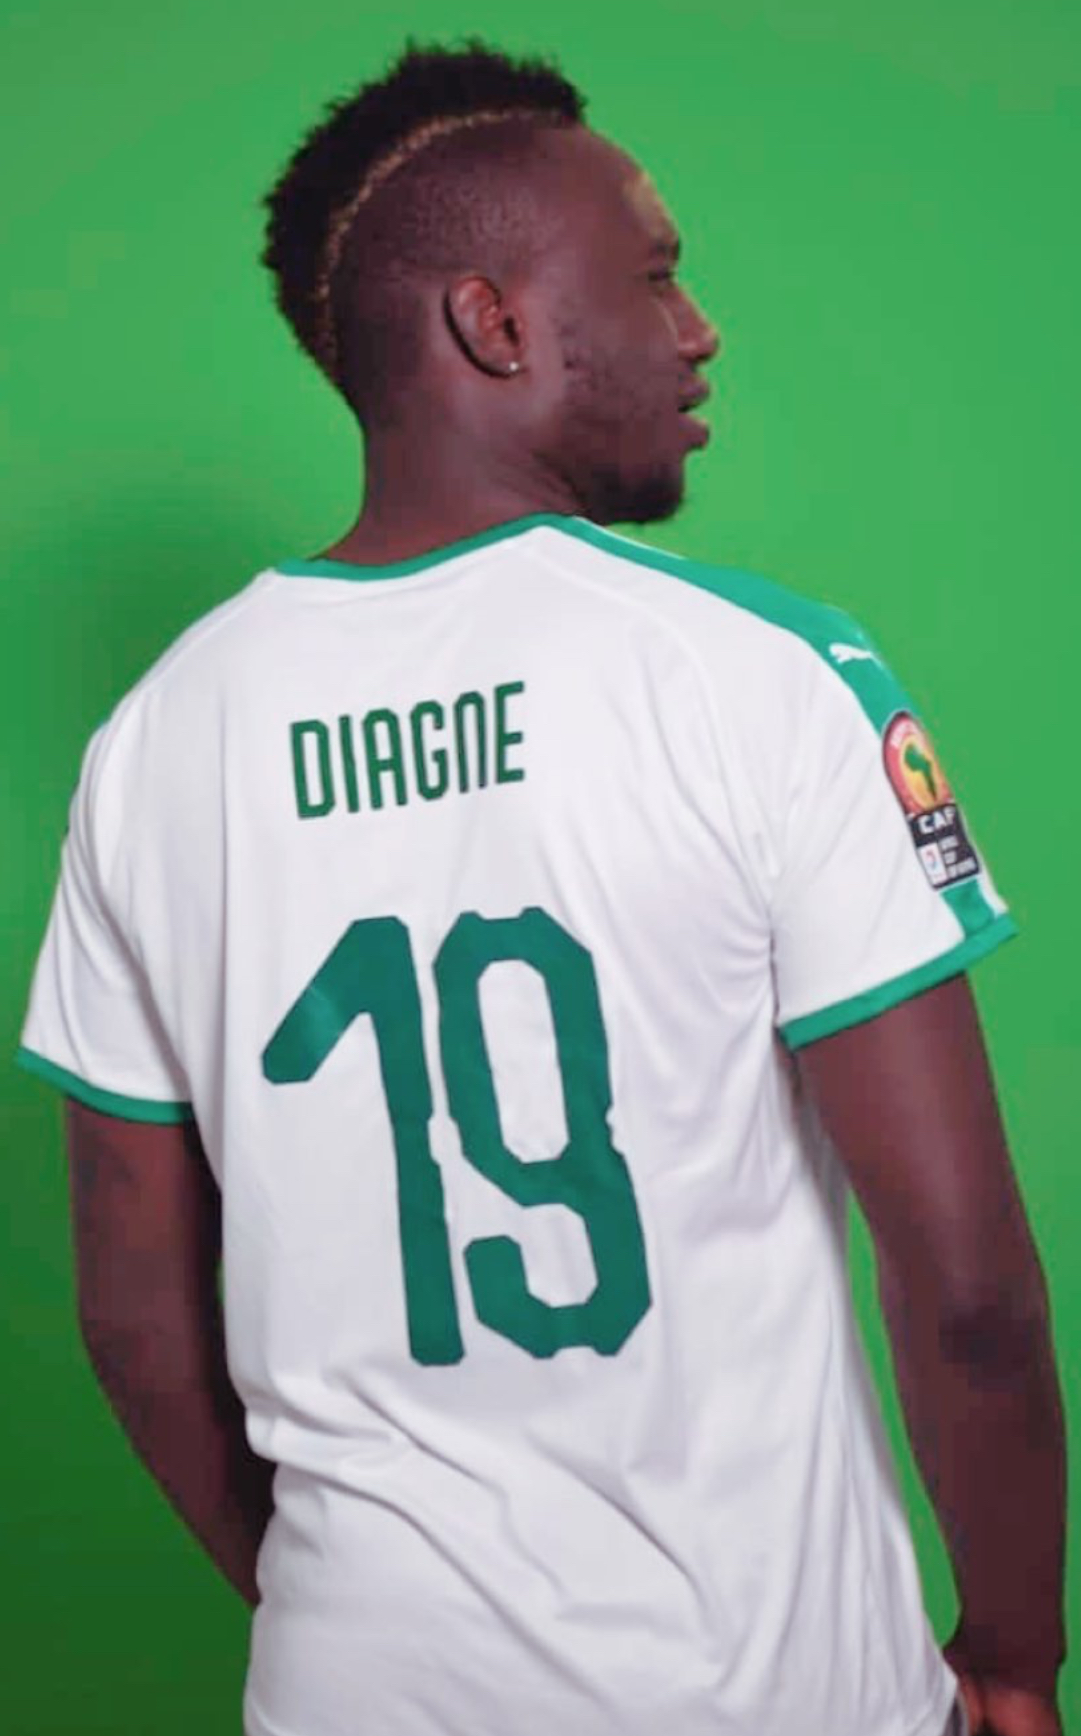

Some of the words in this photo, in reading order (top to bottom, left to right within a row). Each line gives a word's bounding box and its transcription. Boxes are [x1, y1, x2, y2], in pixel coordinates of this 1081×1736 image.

[291, 681, 525, 819] DIAGNE
[918, 808, 956, 835] CAF
[261, 907, 652, 1367] 19
